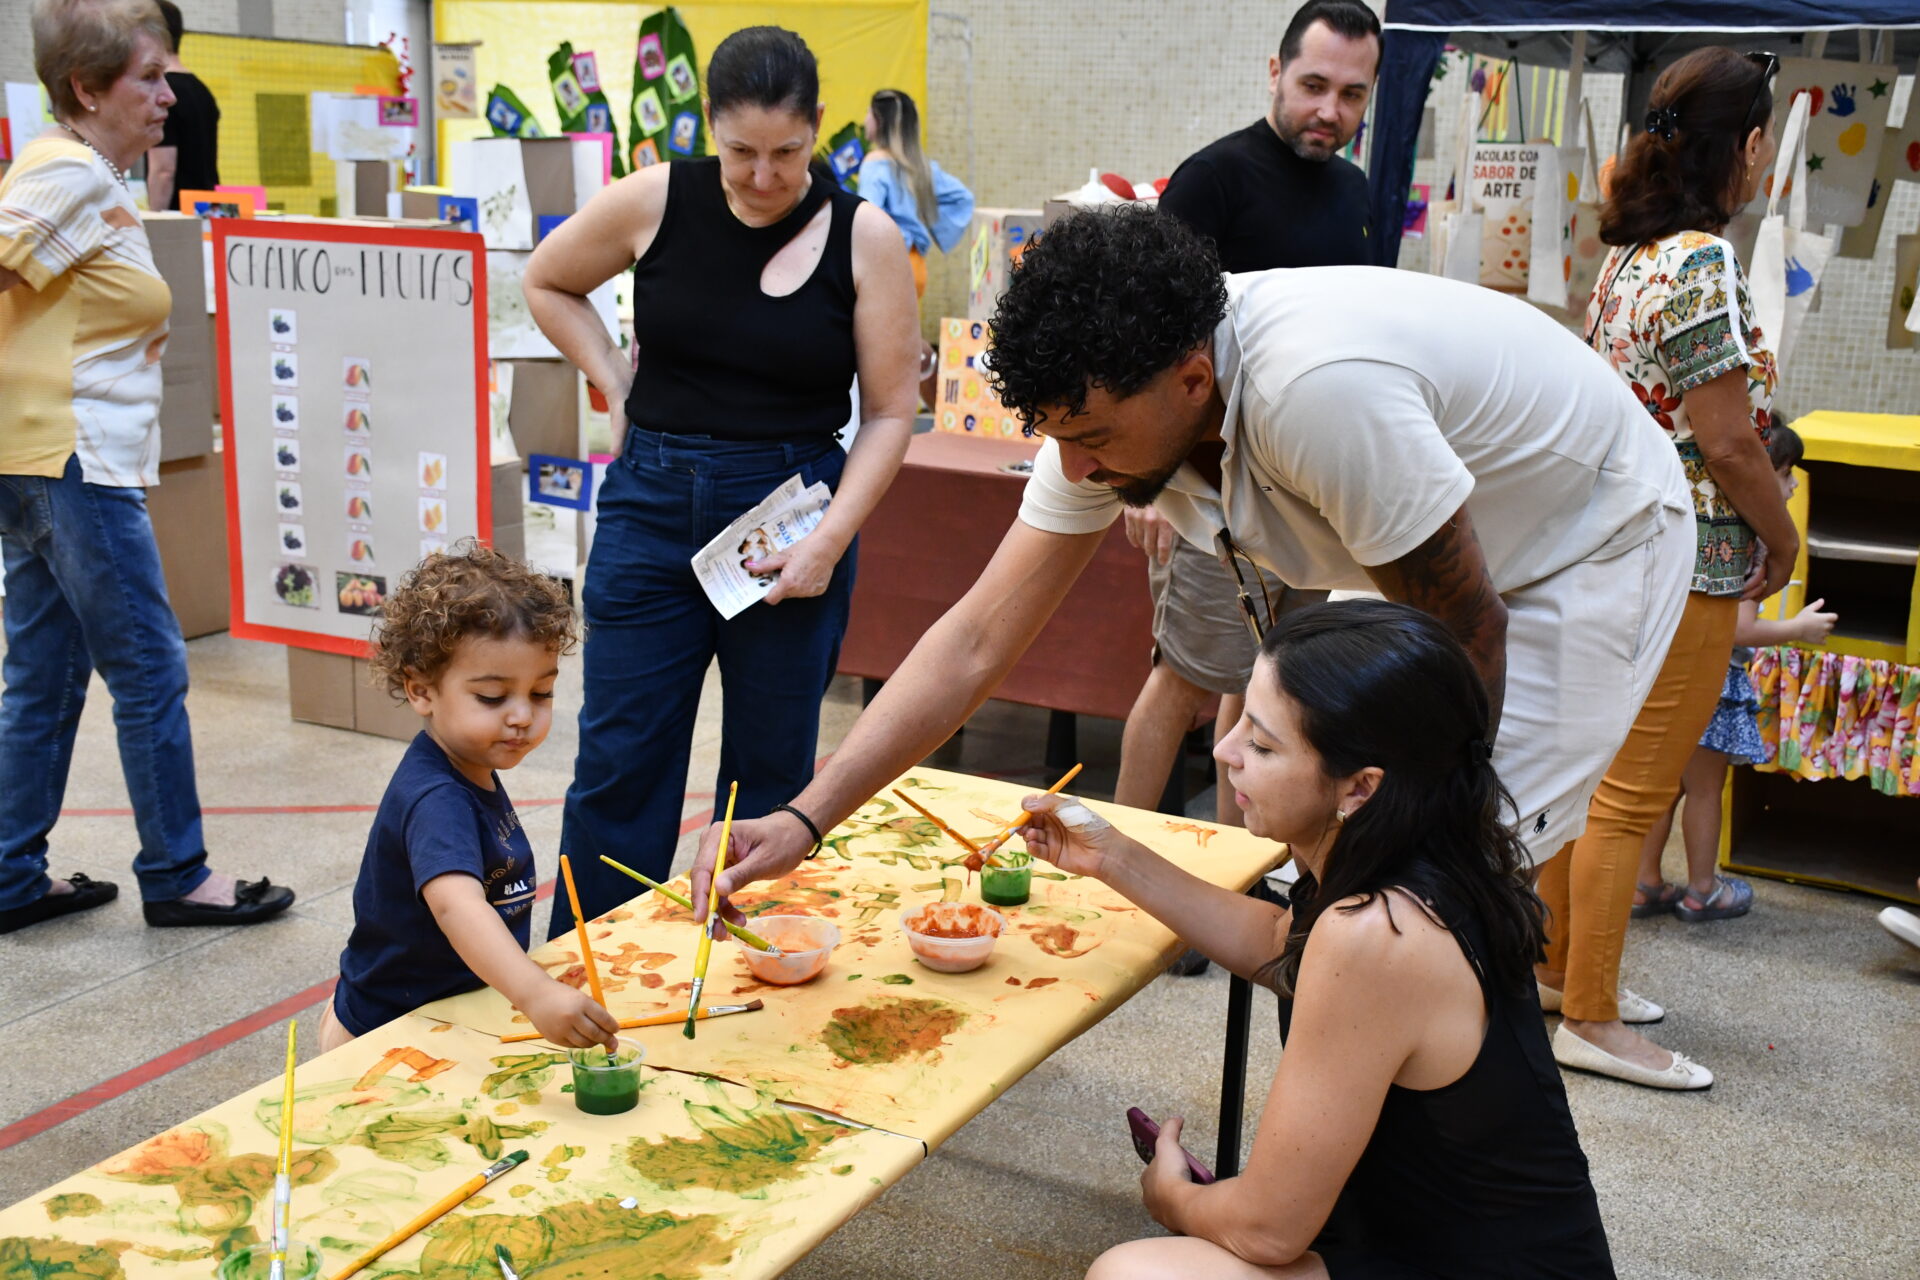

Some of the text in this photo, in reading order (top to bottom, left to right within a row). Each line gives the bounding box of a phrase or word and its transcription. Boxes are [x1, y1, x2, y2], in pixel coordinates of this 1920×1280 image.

[1475, 150, 1515, 162] ACOLAS
[1473, 165, 1536, 180] SABOR DE
[1483, 182, 1522, 198] ARTE
